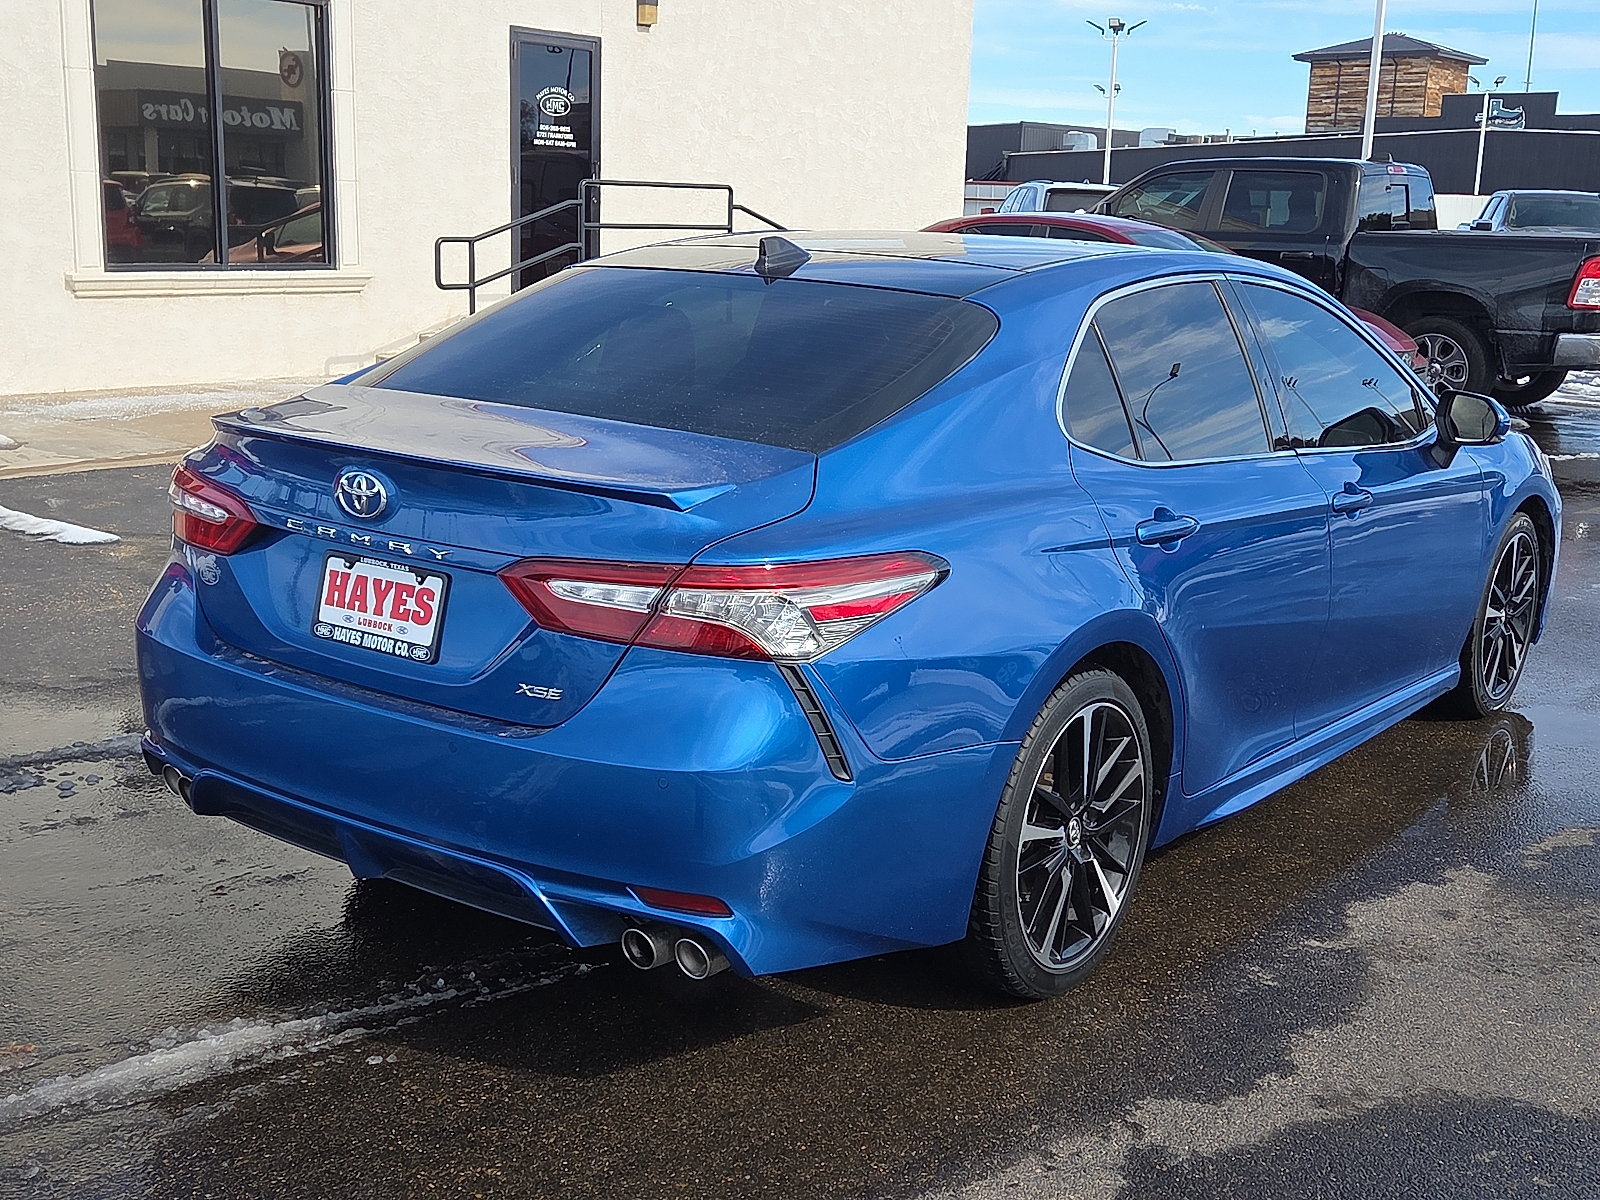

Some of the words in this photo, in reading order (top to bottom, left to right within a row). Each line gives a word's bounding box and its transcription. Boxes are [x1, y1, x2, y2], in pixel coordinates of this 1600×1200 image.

[550, 87, 567, 96] MOTOR
[286, 518, 454, 560] CAMRY
[360, 557, 390, 569] LUBBOCK,
[390, 562, 410, 572] TEXAS
[324, 569, 436, 626] HAYES
[357, 617, 393, 632] LUBBOCK
[333, 627, 362, 645] HAYES
[362, 634, 394, 653] MOTOR
[395, 641, 409, 657] CO.
[514, 682, 564, 700] XSE
